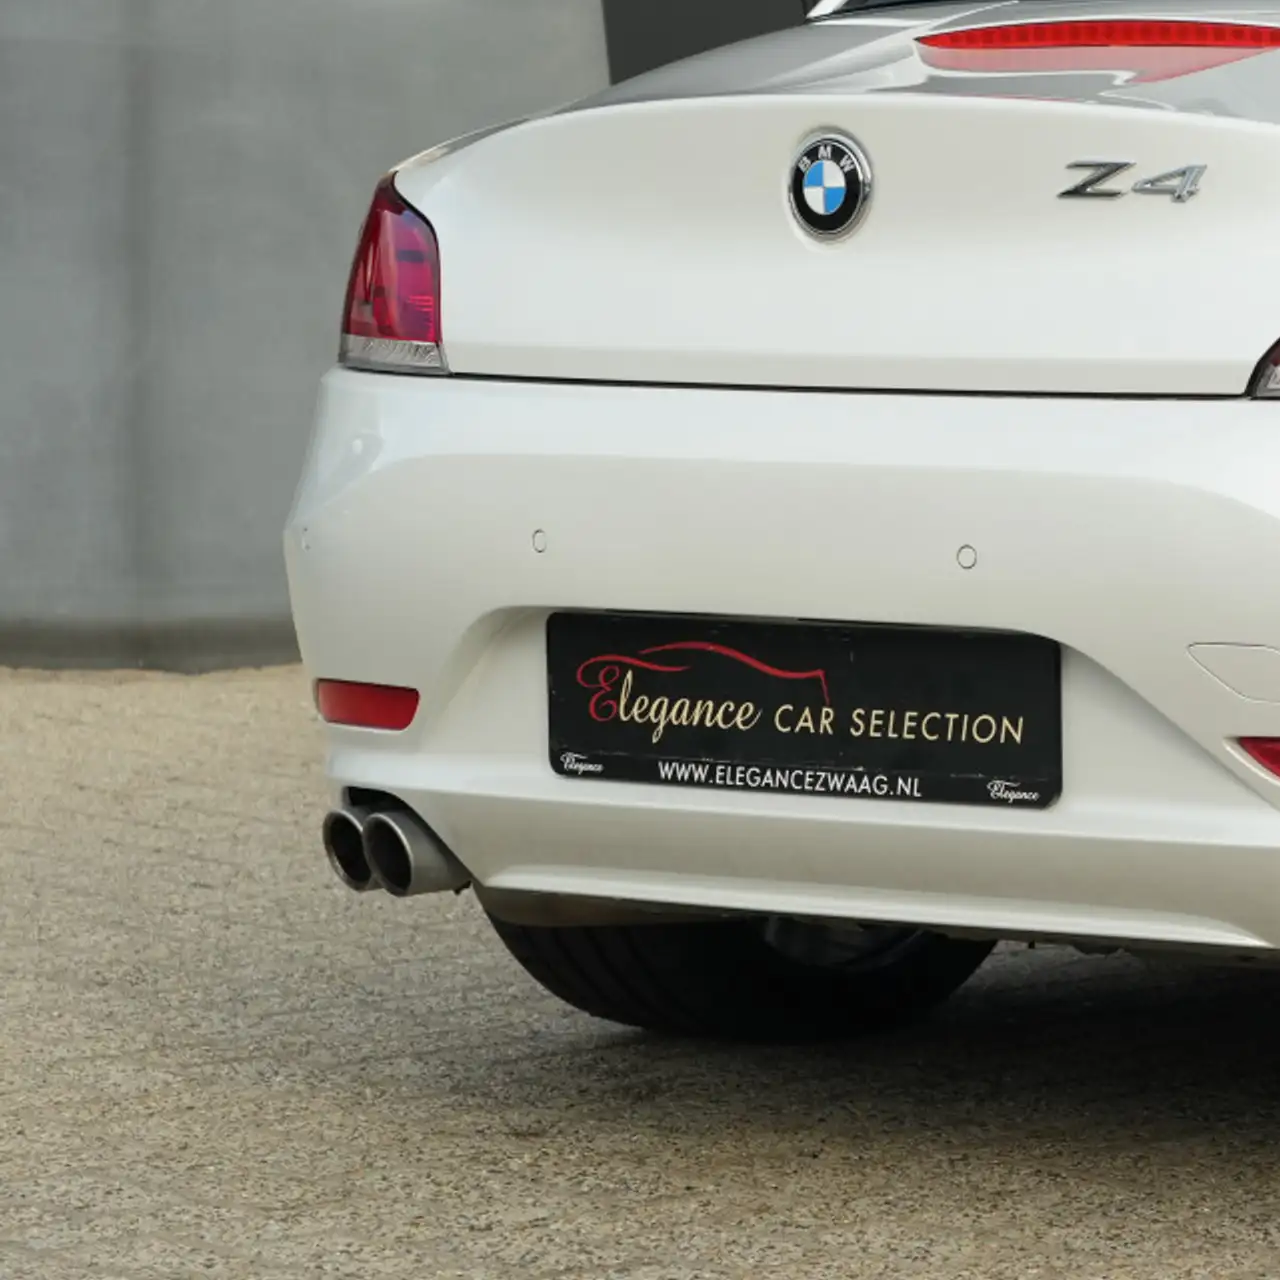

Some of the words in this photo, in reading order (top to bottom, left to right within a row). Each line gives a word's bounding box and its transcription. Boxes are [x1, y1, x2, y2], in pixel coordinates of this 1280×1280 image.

[797, 144, 857, 173] BMW
[1057, 160, 1208, 204] Z4
[577, 655, 761, 744] Elegance
[773, 704, 834, 736] CAR
[849, 708, 1025, 745] SELECTION
[658, 760, 923, 798] WWW.ELEGANCEZWAAG.NL
